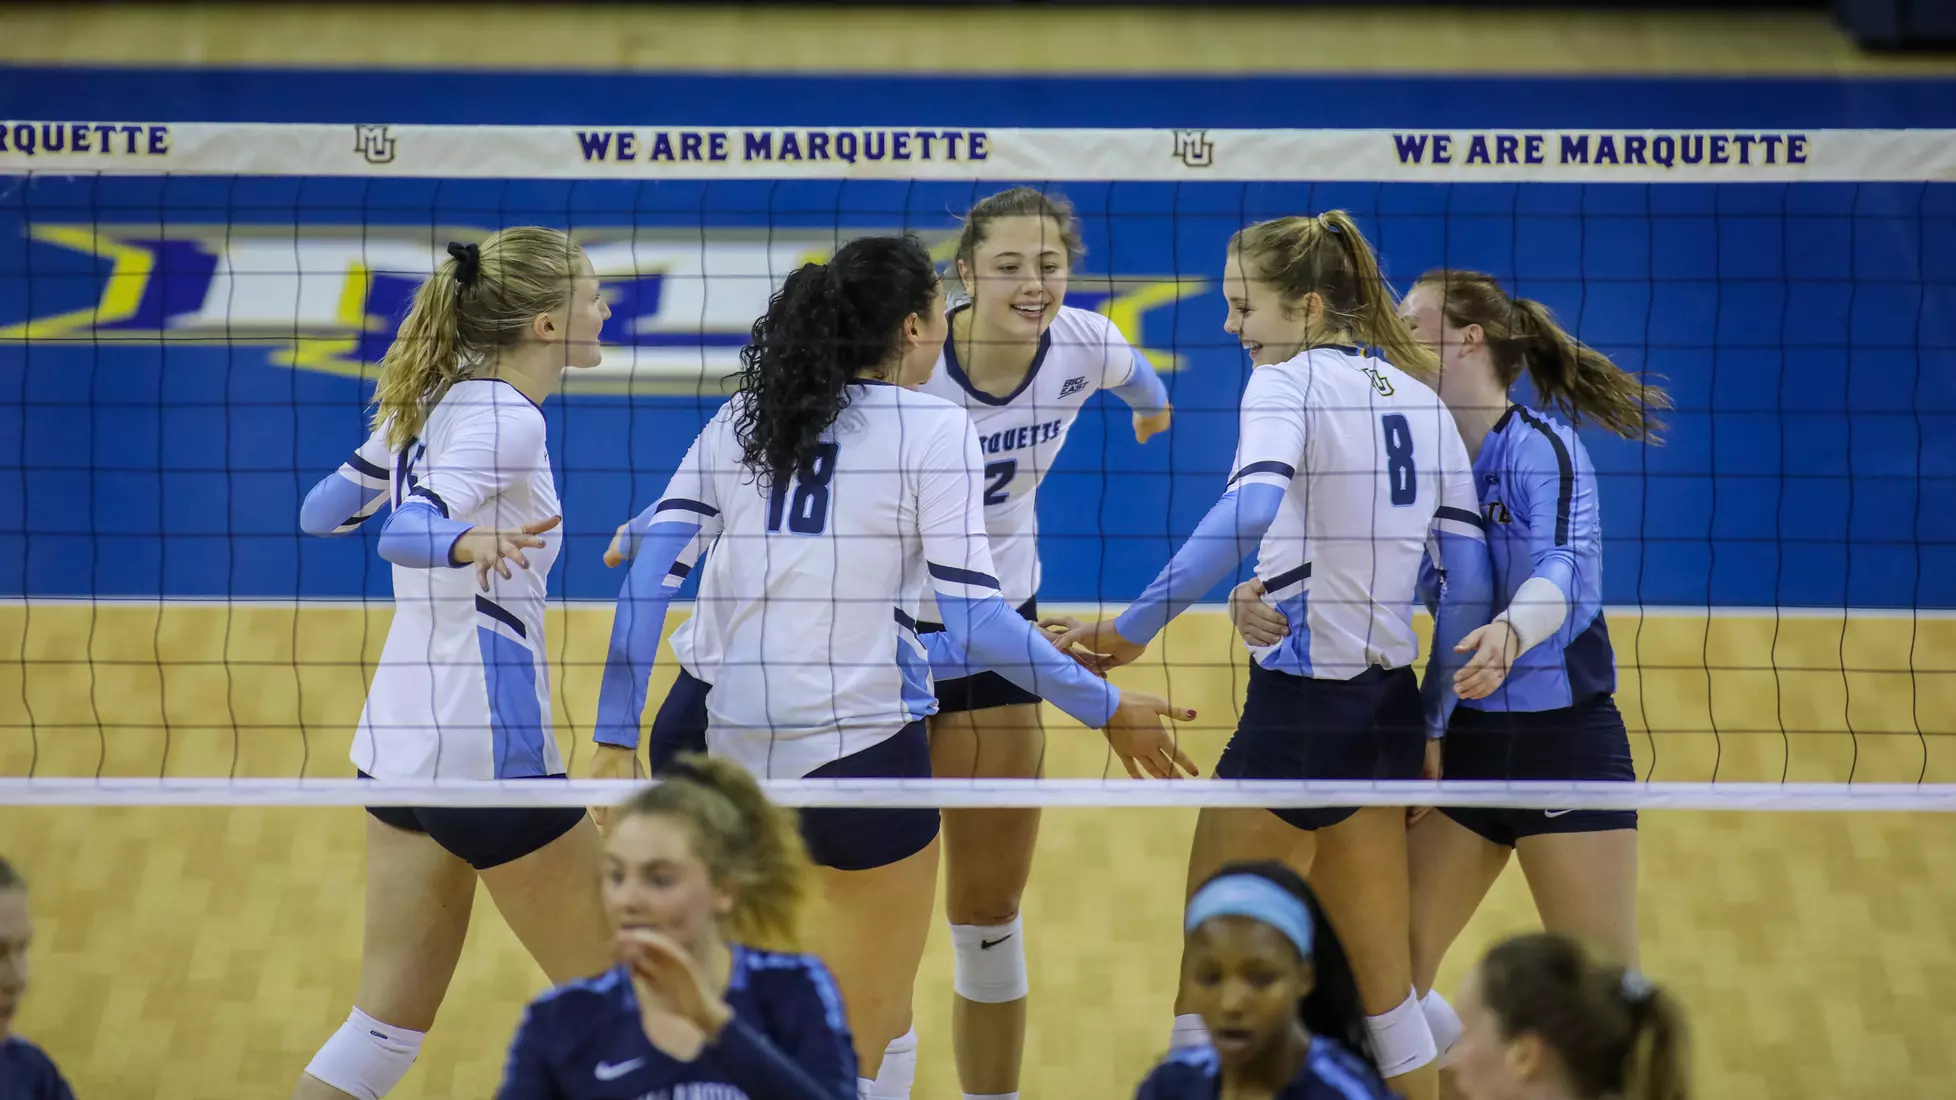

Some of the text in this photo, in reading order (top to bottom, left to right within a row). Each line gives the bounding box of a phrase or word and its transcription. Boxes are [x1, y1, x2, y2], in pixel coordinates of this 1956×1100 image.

[354, 124, 396, 164] MU
[576, 131, 989, 164] WE ARE MARQUETTE
[1172, 128, 1213, 168] MU
[1393, 134, 1808, 169] WE ARE MARQUETTE
[1063, 375, 1085, 388] BIG
[1381, 412, 1418, 508] 8
[766, 441, 841, 537] 18
[983, 458, 1018, 507] 2
